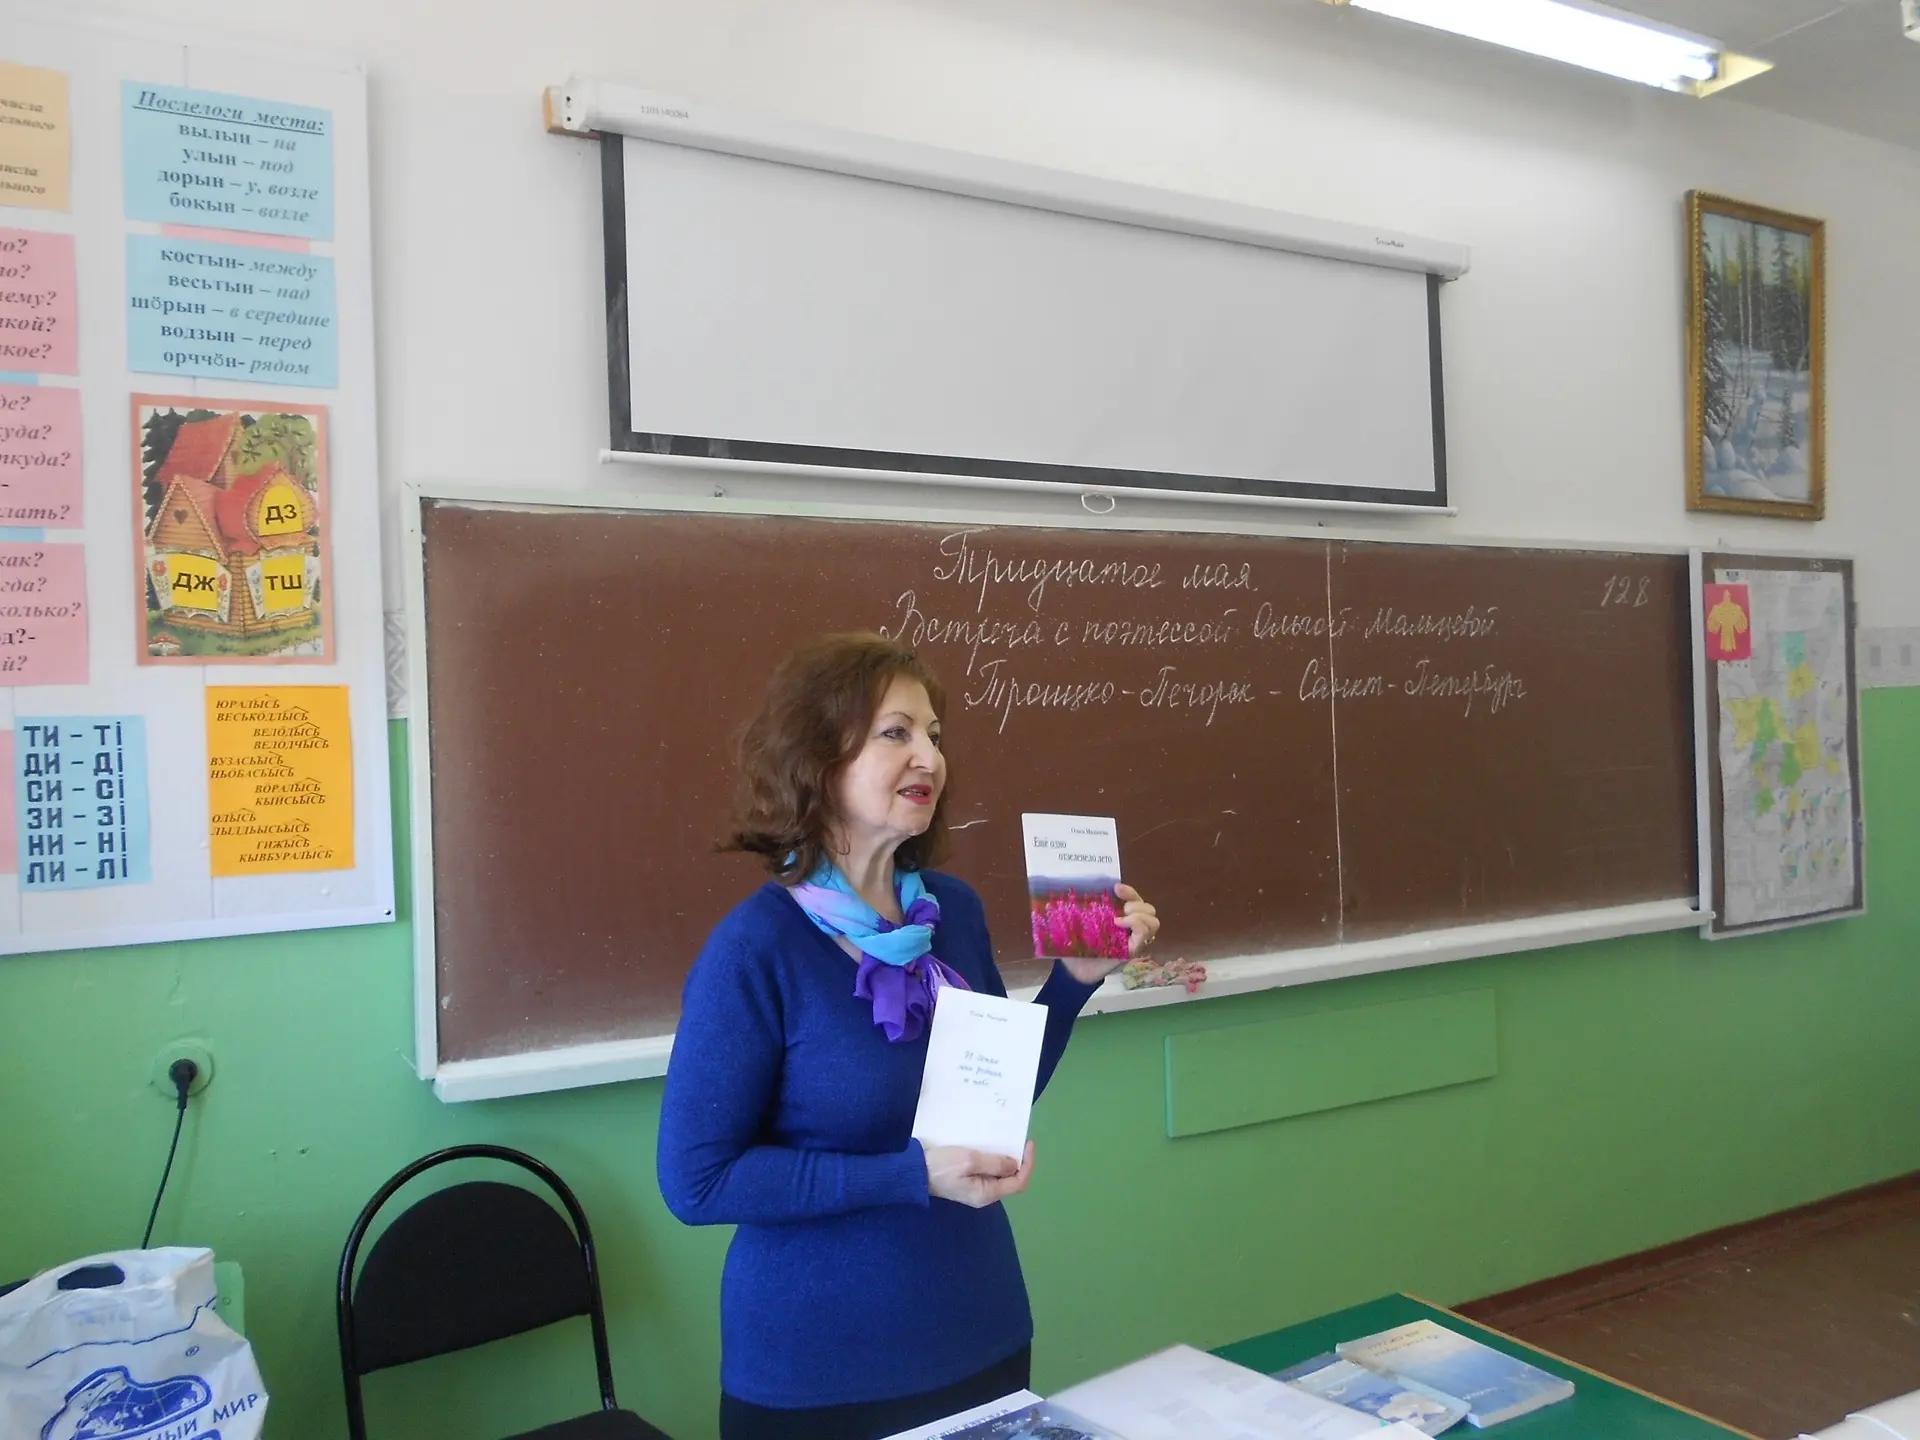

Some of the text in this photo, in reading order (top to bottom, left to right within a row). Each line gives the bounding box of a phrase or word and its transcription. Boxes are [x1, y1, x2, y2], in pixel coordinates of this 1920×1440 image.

[138, 91, 324, 131] Послелоги места:
[179, 124, 251, 145] вылын
[182, 148, 236, 166] улын
[259, 159, 294, 173] под
[157, 170, 224, 188] дорын
[268, 184, 319, 200] возле
[169, 192, 235, 214] бокын
[258, 206, 309, 222] возле
[249, 260, 317, 281] между
[0, 291, 57, 309] ему?
[168, 275, 253, 294] весьтын
[276, 286, 311, 300] над
[0, 316, 57, 332] кой?
[245, 308, 330, 327] середине
[0, 343, 52, 359] кое?
[161, 325, 235, 342] водзын
[258, 334, 312, 352] перед
[249, 358, 310, 375] рядом
[933, 527, 1165, 612] Тридцатое
[1601, 575, 1650, 607] 128
[880, 590, 1044, 675] Встреча
[1055, 621, 1071, 646] с
[1082, 608, 1239, 646] поэтессой
[1253, 602, 1353, 639] Ольгой
[212, 1393, 258, 1423] МИР
